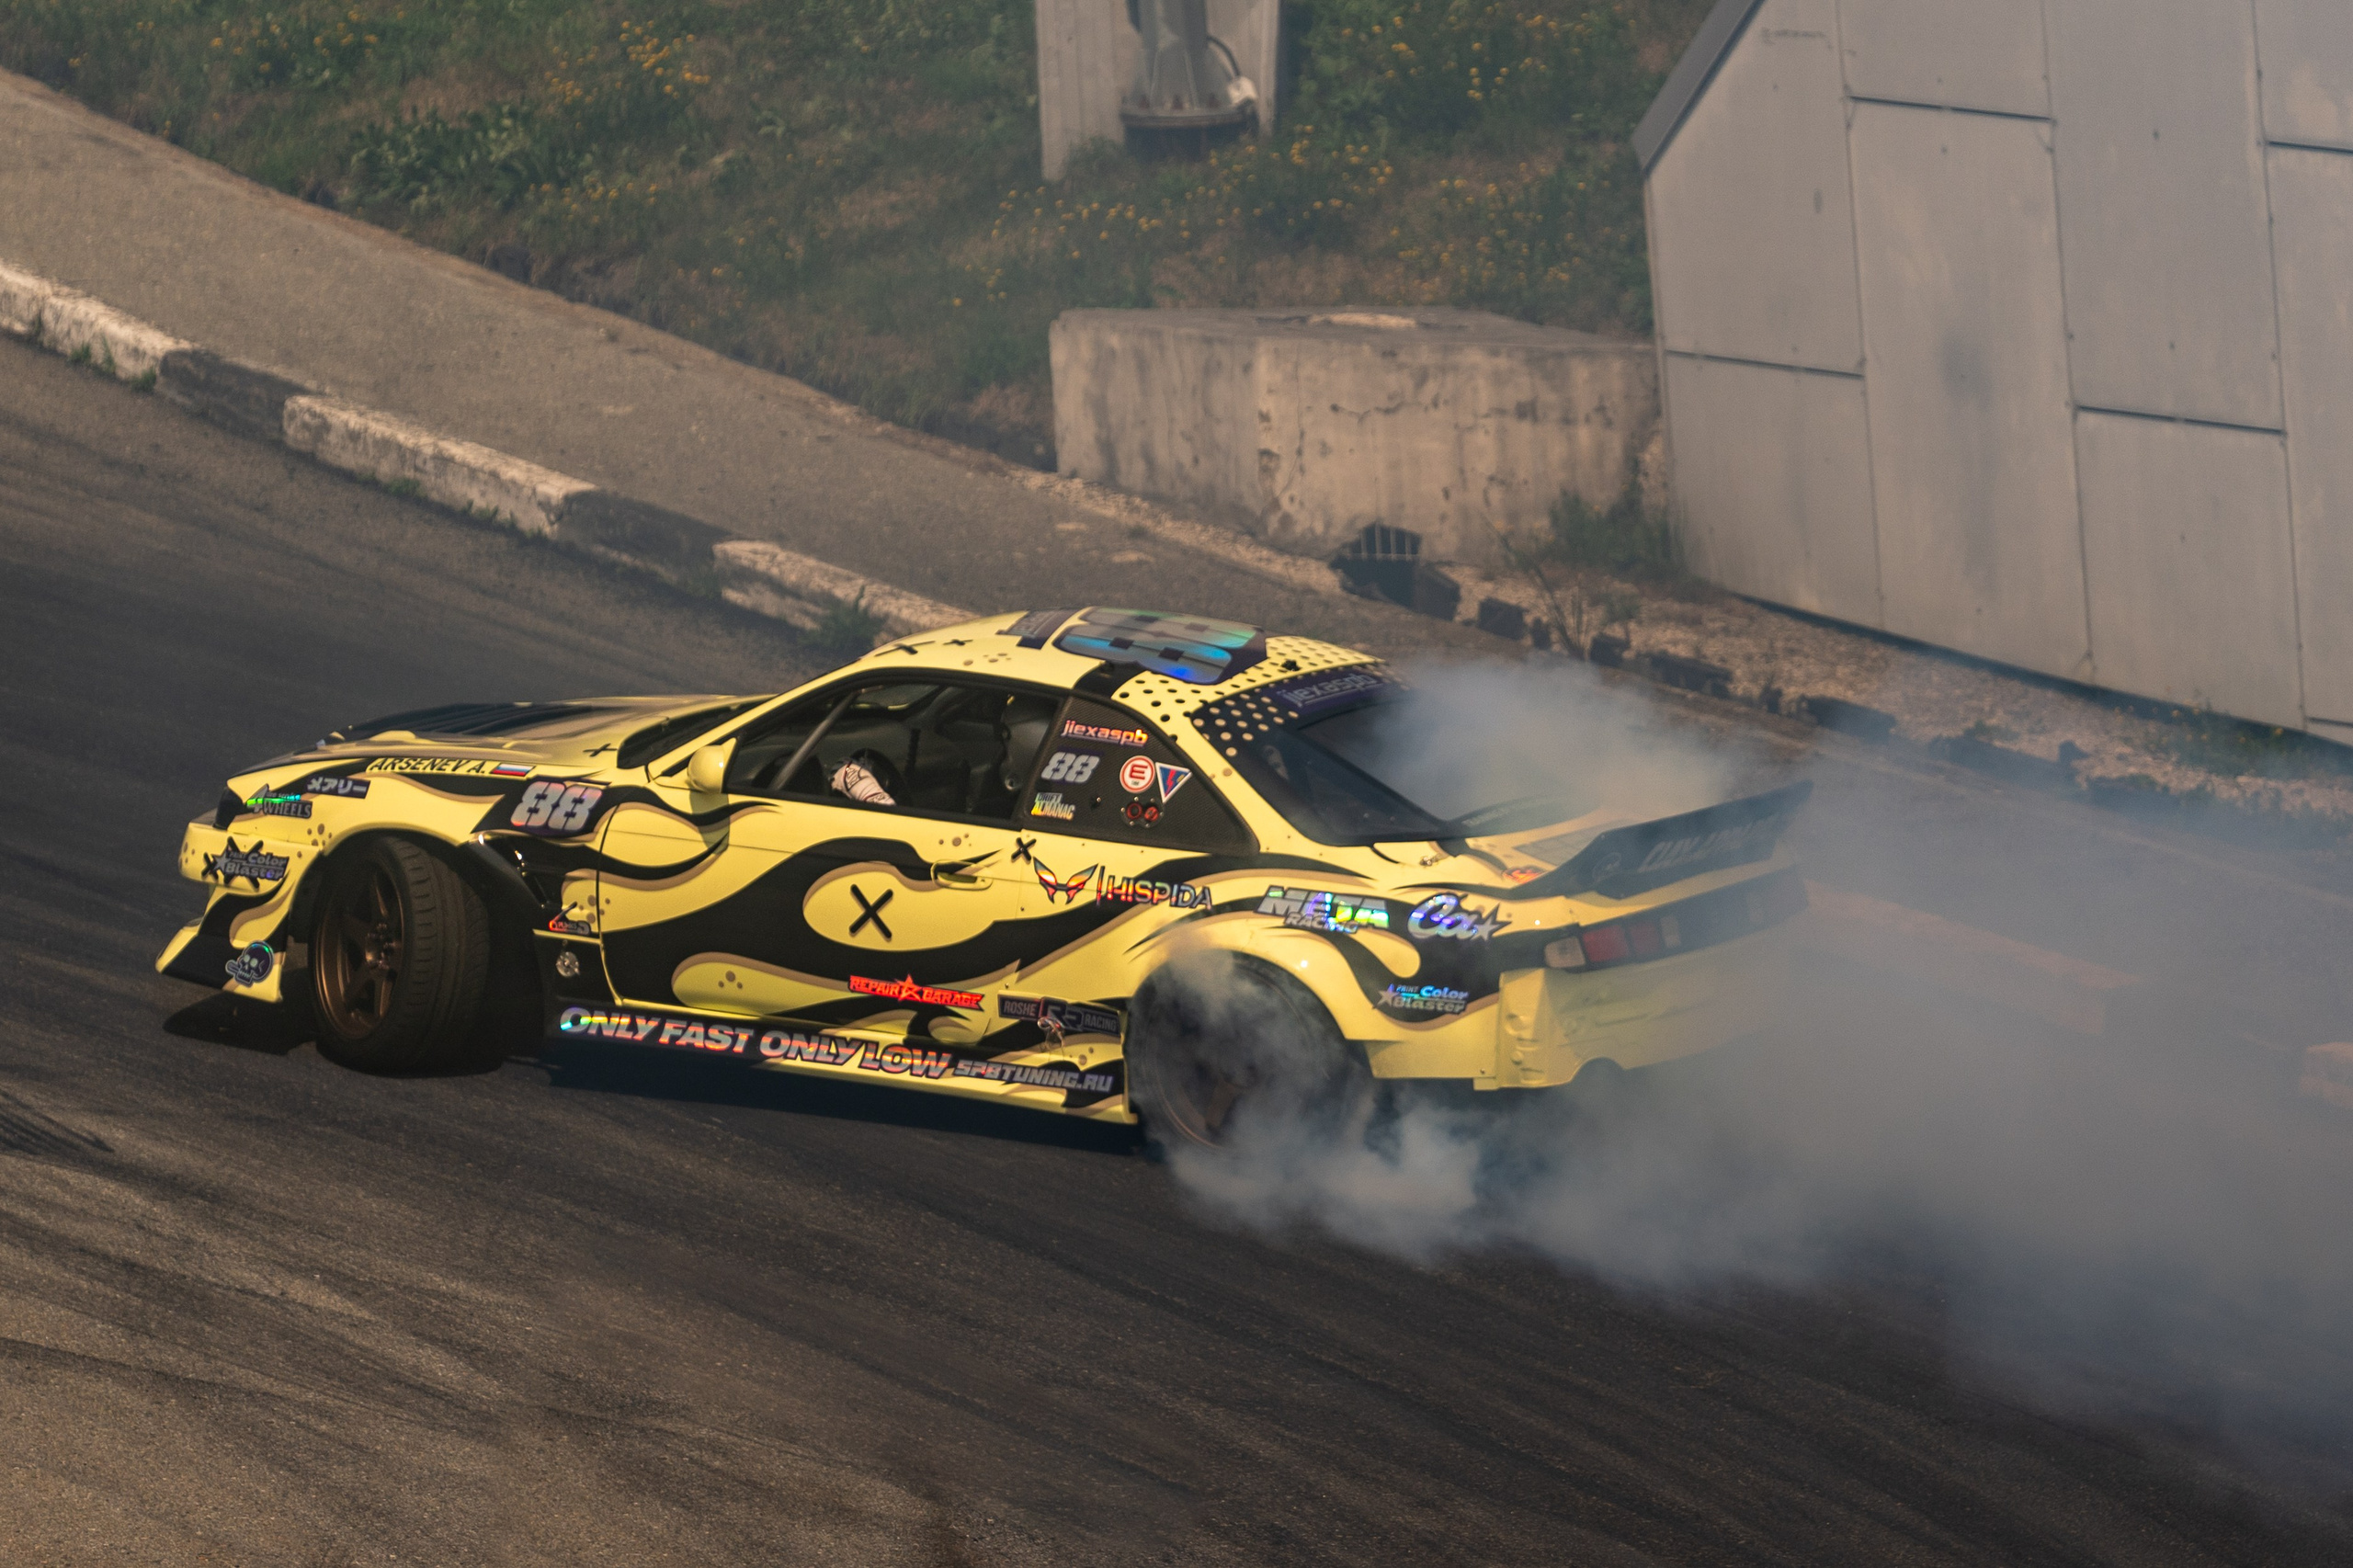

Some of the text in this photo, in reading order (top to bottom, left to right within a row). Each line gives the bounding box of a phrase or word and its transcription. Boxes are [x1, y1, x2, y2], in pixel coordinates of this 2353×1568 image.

[369, 757, 486, 774] ARSENEV A.
[1040, 751, 1100, 782] 88
[307, 777, 368, 795] メアリー
[509, 780, 604, 831] 88
[1031, 801, 1076, 821] ALMANAC
[247, 852, 288, 866] Color
[226, 862, 284, 880] Blaster
[1285, 912, 1358, 934] RACING
[849, 976, 982, 1006] REPAIR GARAGE
[1420, 984, 1469, 1000] Color
[1392, 995, 1466, 1013] Blaster
[1003, 1000, 1038, 1017] ROSHE
[1085, 1014, 1118, 1032] RACING
[559, 1006, 658, 1041] ONLY
[658, 1018, 754, 1053] FAST
[759, 1030, 865, 1065] ONLY
[858, 1041, 952, 1079] LOW
